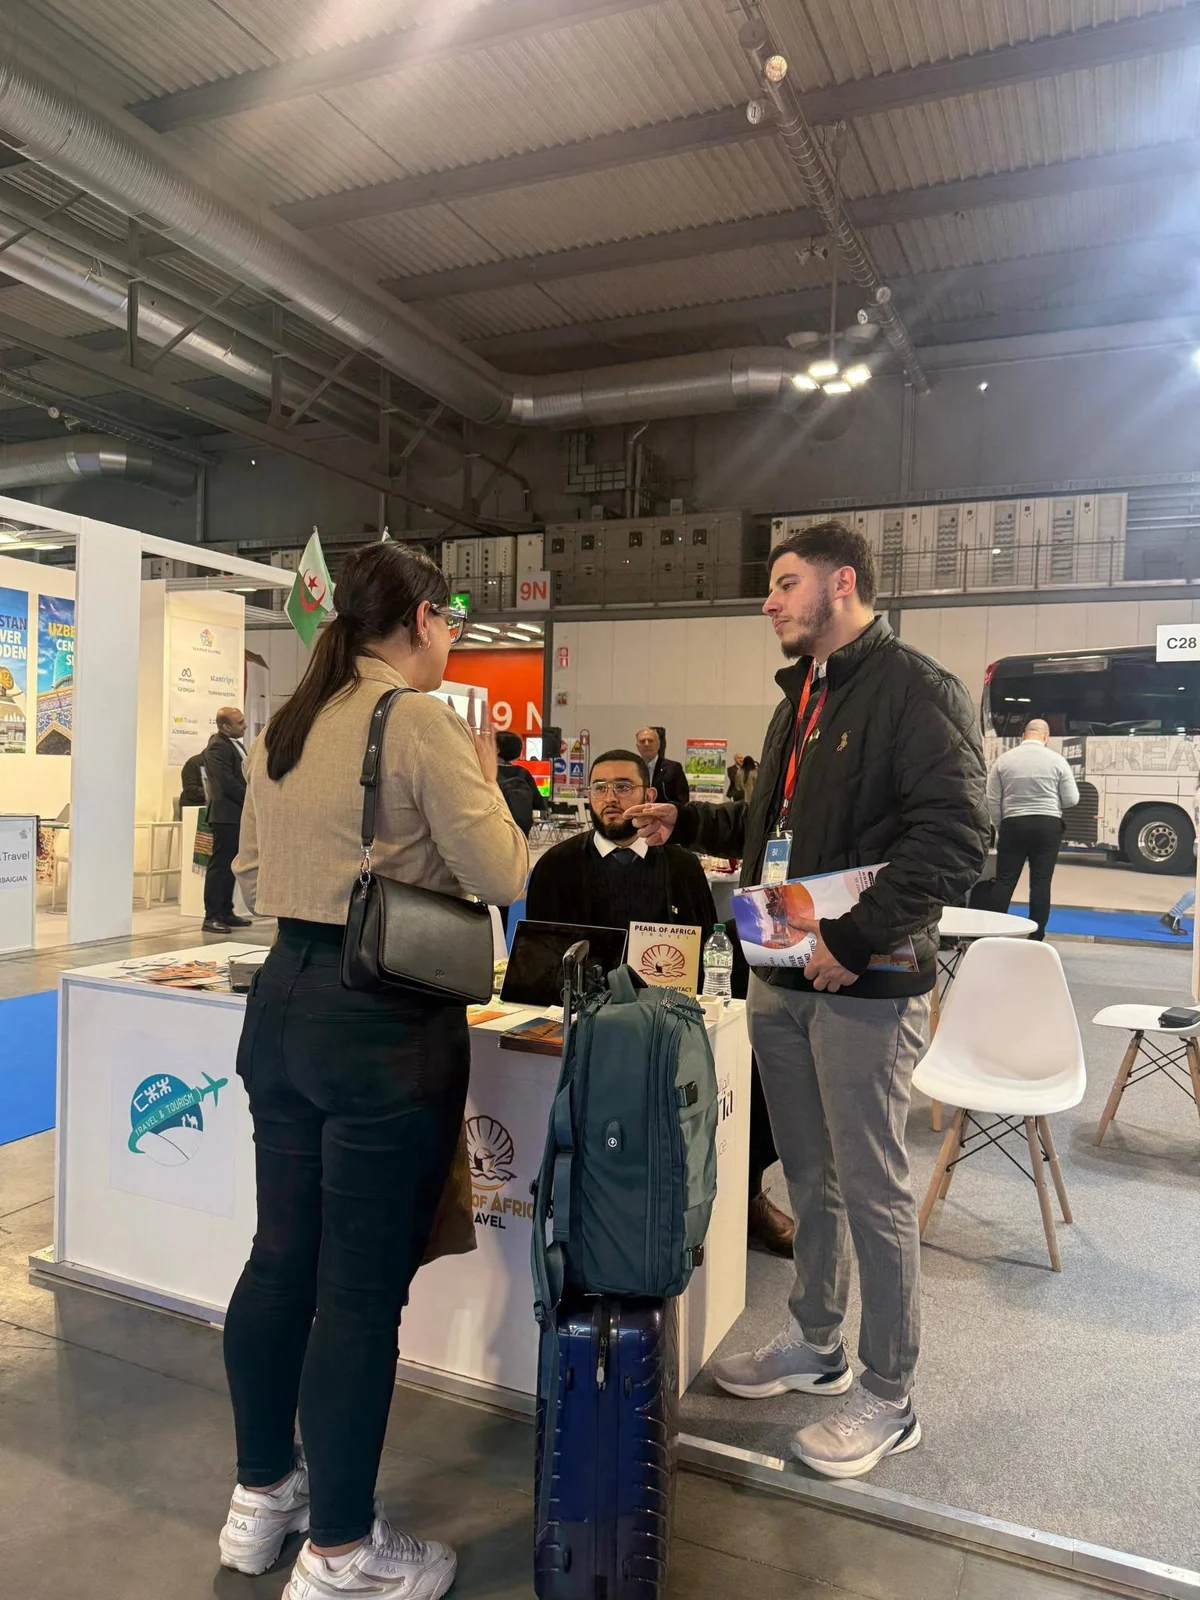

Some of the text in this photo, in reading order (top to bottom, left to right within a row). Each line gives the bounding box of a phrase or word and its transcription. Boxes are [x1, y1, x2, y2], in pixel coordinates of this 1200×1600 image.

[520, 580, 547, 601] 9N
[0, 614, 27, 631] STAN
[0, 629, 21, 645] VER
[1166, 637, 1197, 649] C28
[2, 850, 30, 861] Travel
[634, 924, 657, 933] PEARL
[670, 927, 697, 936] AFRICA
[135, 1092, 195, 1137] TRAVEL & TOURISM
[472, 1192, 534, 1219] OF AFRIC
[474, 1212, 506, 1230] AVEL
[229, 1516, 248, 1531] FILA
